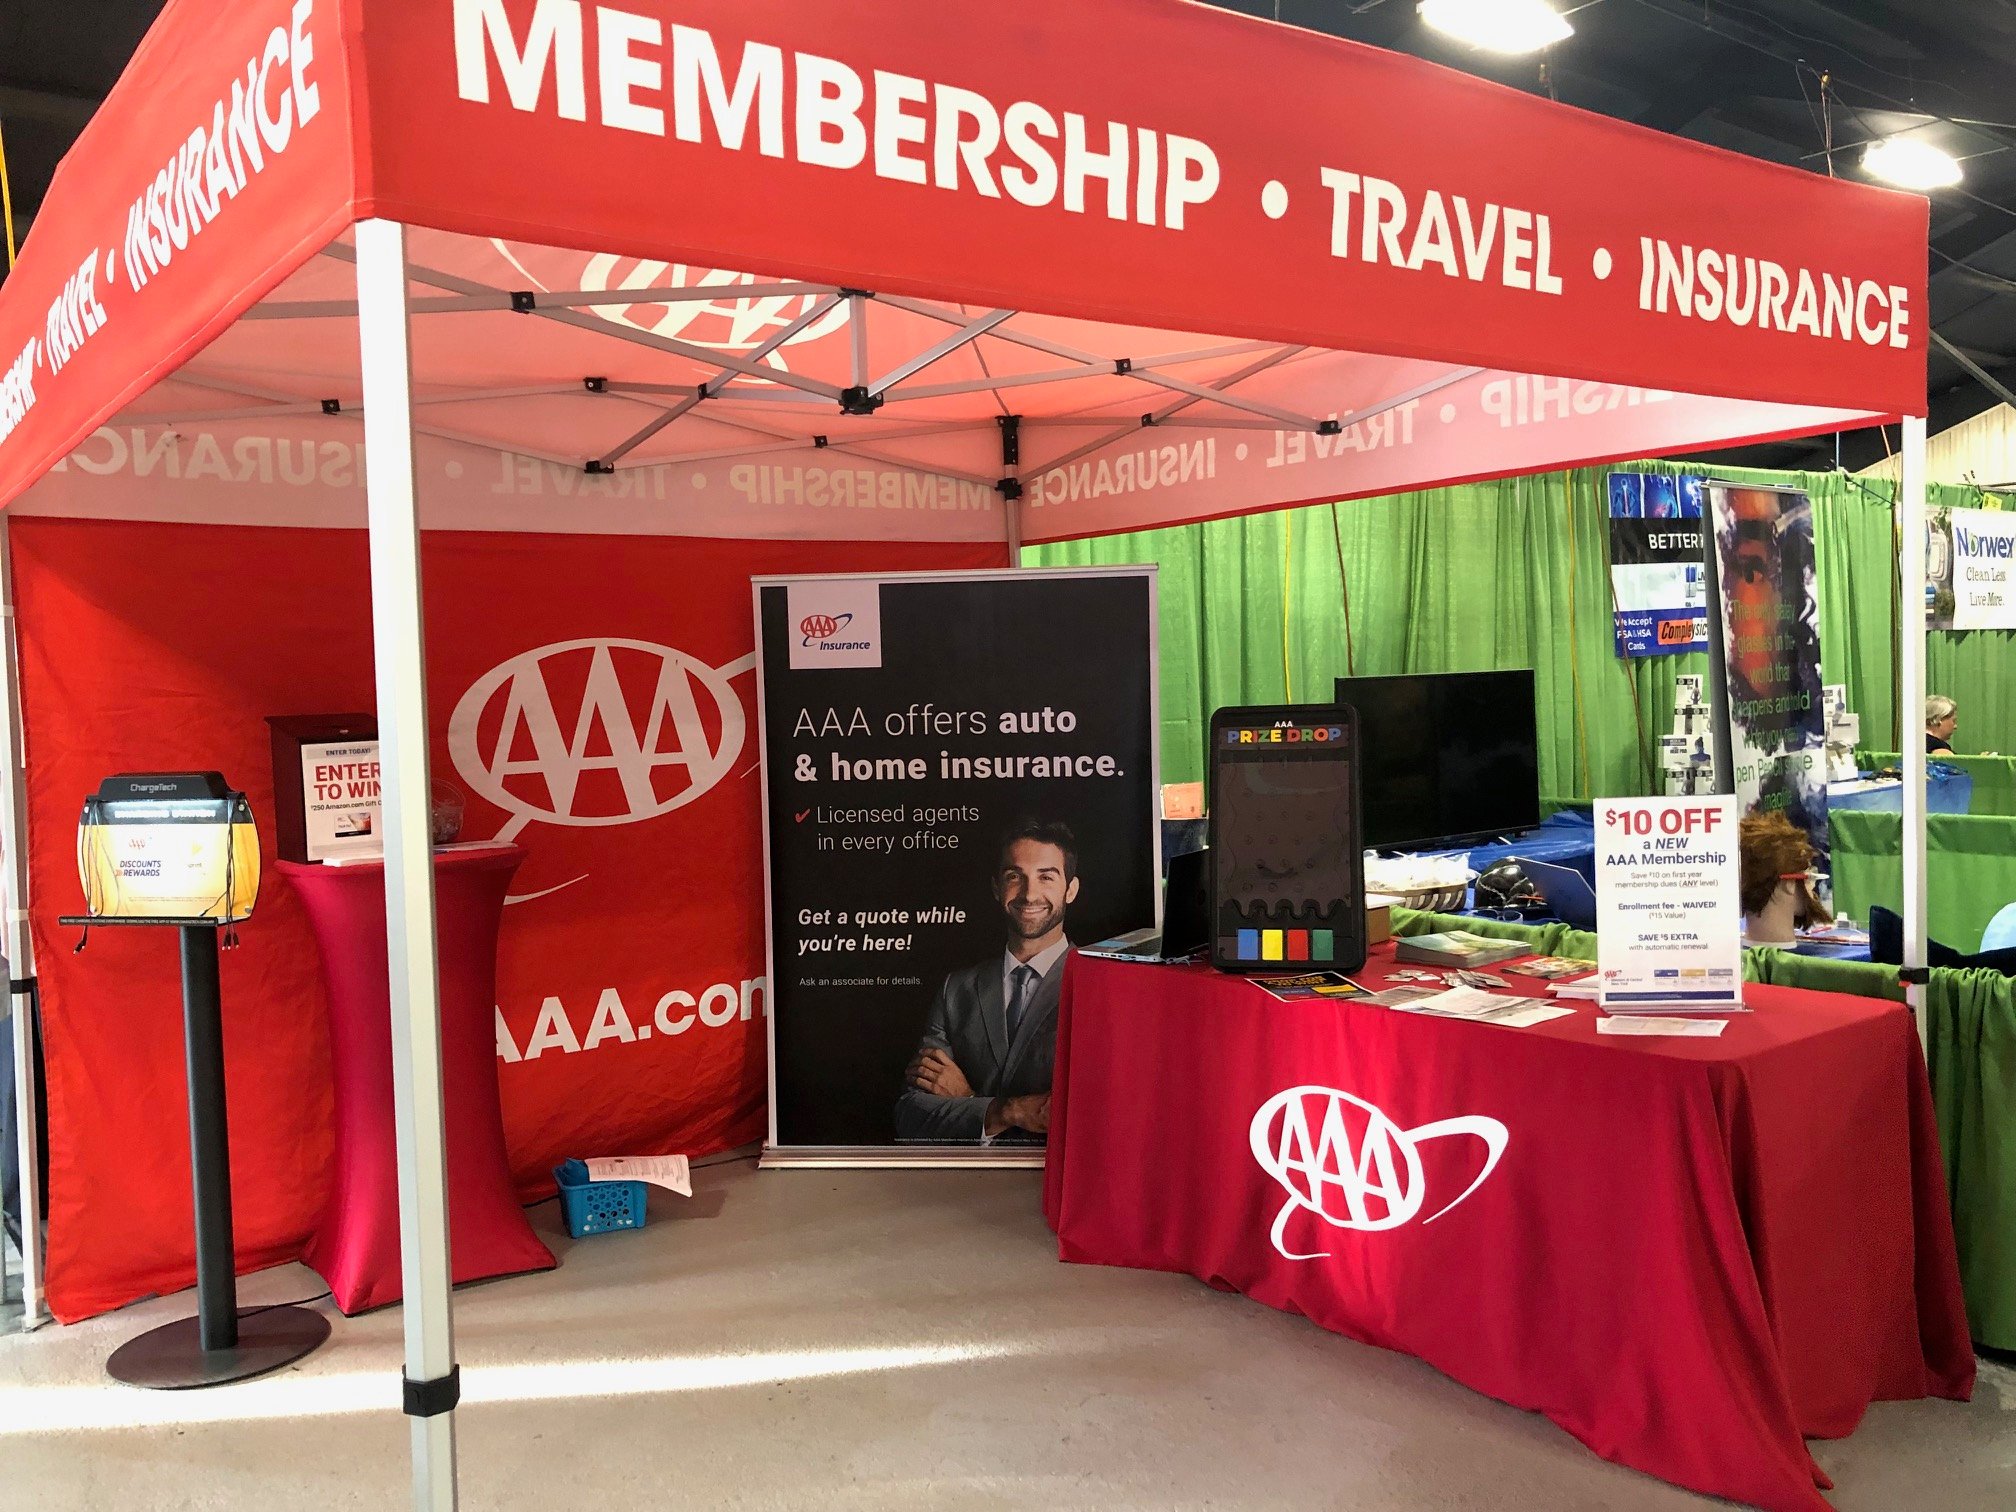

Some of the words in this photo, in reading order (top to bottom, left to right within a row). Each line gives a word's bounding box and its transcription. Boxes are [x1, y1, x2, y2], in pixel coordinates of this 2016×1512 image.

[124, 0, 321, 293] INSURANCE
[453, 0, 1220, 231] MEMBERSHIP
[1321, 167, 1563, 296] TRAVEL
[1639, 237, 1909, 349] INSURANCE
[1648, 533, 1699, 549] BETTER
[1956, 527, 2014, 559] Norwex
[1966, 566, 1990, 582] Clean
[804, 615, 834, 638] AAA
[1628, 616, 1653, 627] Accept
[820, 641, 871, 651] Insurance
[793, 706, 871, 738] AAA
[885, 703, 988, 736] offers
[999, 706, 1077, 734] auto
[1274, 720, 1294, 728] AAA
[488, 643, 715, 818] AAA
[1227, 729, 1282, 744] PRIZE
[1286, 727, 1341, 743] DROP
[315, 762, 380, 782] ENTER
[794, 753, 818, 782] &
[831, 752, 927, 781] home
[940, 750, 1124, 780] insurance.
[130, 783, 178, 794] ChargeTech
[314, 783, 343, 801] TO
[325, 802, 364, 810] Amazon.com
[817, 804, 905, 824] Licensed
[912, 804, 980, 827] agents
[1605, 808, 1652, 836] $10
[1660, 807, 1722, 835] OFF
[818, 833, 835, 851] in
[842, 835, 895, 855] every
[902, 830, 960, 850] office
[1643, 840, 1651, 850] a
[1655, 837, 1689, 850] NEW
[119, 860, 161, 868] DISCOUNTS
[1606, 854, 1638, 866] AAA
[1641, 851, 1727, 867] Membership
[123, 869, 160, 877] REWARDS
[1630, 872, 1648, 880] Save
[1672, 871, 1686, 879] first
[1687, 871, 1702, 880] year
[1615, 880, 1659, 890] membership
[1660, 880, 1677, 888] dues
[1679, 880, 1698, 889] (ANY
[1699, 879, 1718, 888] level)
[1618, 901, 1660, 910] Enrollment
[1662, 902, 1675, 910] fee
[1682, 901, 1717, 909] WAIVED!
[798, 908, 831, 926] Get
[837, 911, 848, 925] a
[855, 908, 910, 929] quote
[916, 906, 967, 924] while
[1664, 911, 1687, 920] Value)
[798, 934, 857, 957] you're
[862, 934, 913, 952] here!
[1638, 934, 1659, 942] SAVE
[1670, 933, 1698, 941] EXTRA
[1645, 943, 1679, 951] automatic
[1681, 942, 1708, 950] renewal
[799, 977, 816, 987] Ask
[818, 977, 830, 987] an
[832, 976, 875, 987] associate
[876, 976, 890, 986] for
[891, 975, 923, 986] details.
[1275, 1091, 1409, 1225] AAA
